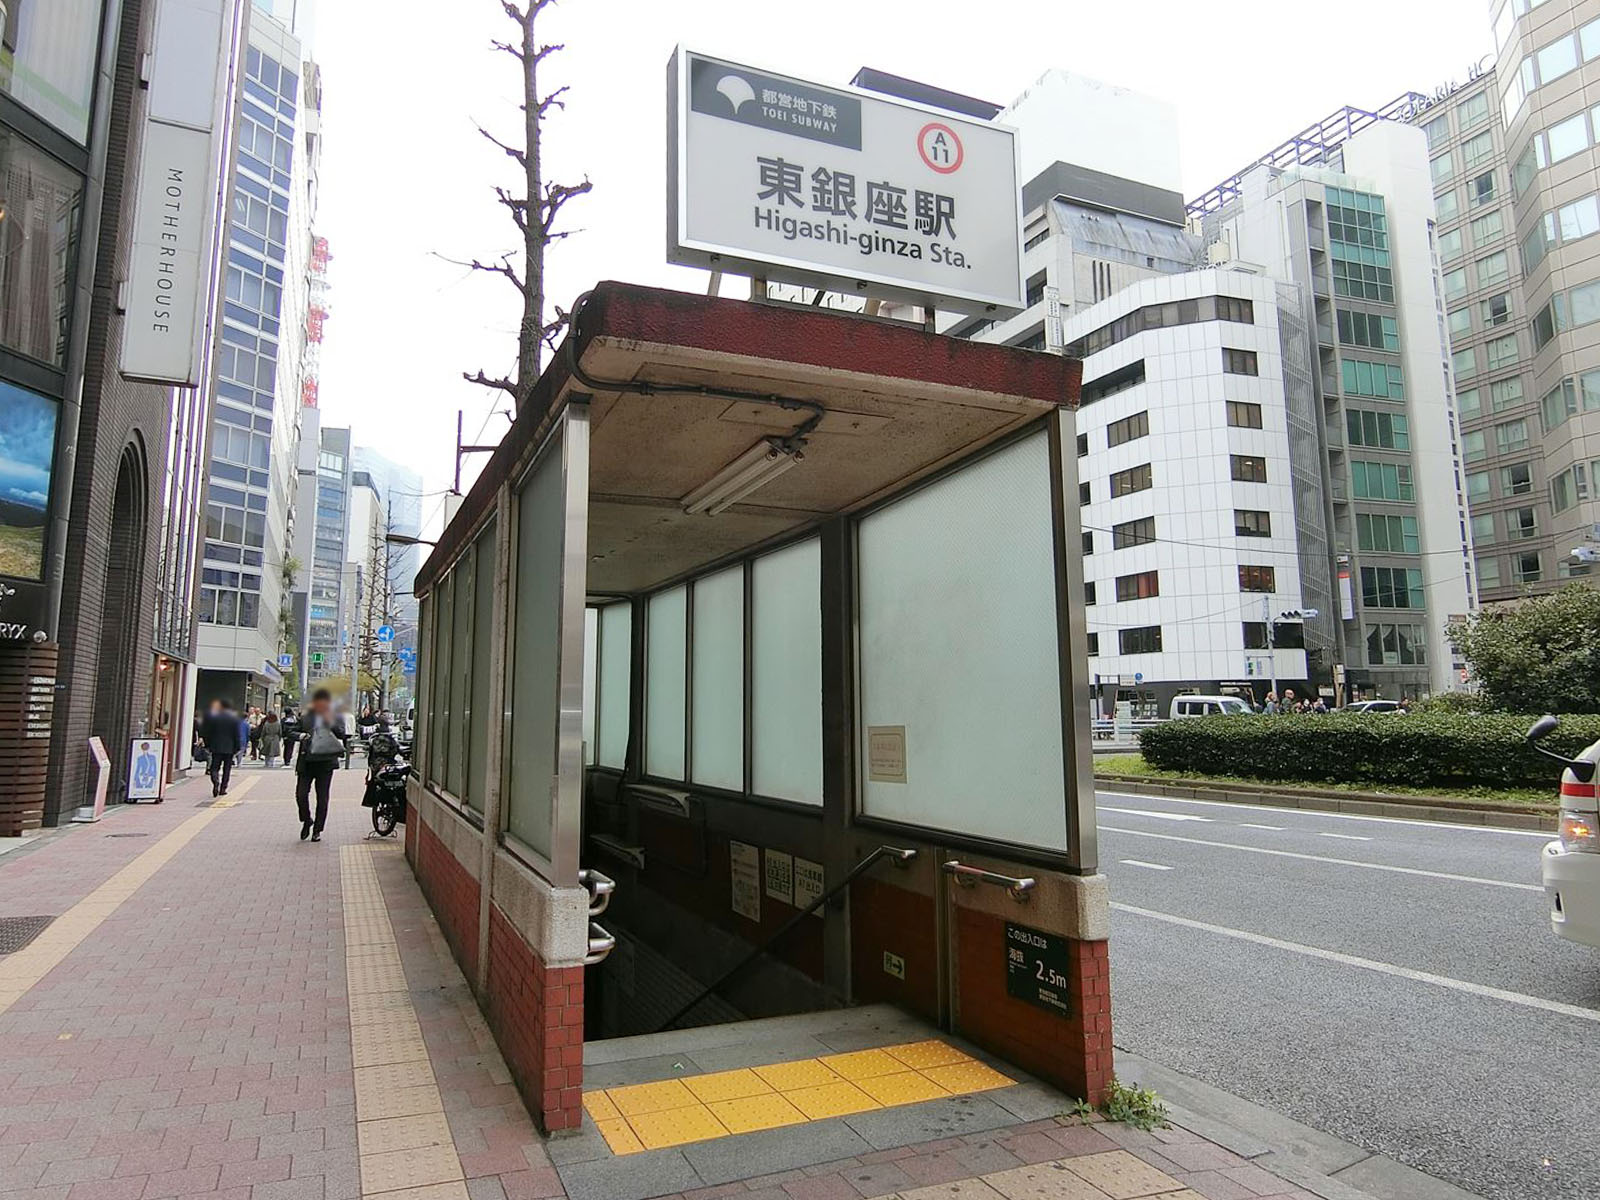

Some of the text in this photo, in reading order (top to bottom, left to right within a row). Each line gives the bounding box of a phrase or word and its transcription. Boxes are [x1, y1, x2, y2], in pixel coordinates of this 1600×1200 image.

[762, 89, 837, 119] 都営地下鉄
[762, 107, 837, 134] TOEI SUBWAY
[934, 132, 947, 147] A
[931, 146, 951, 164] 11
[755, 155, 956, 241] 東銀座駅
[153, 169, 183, 332] MOTHERHOUSE
[753, 205, 972, 270] Higashi-ginza Sta.
[1007, 927, 1048, 950] この出入口は
[1035, 959, 1067, 989] 2.5m
